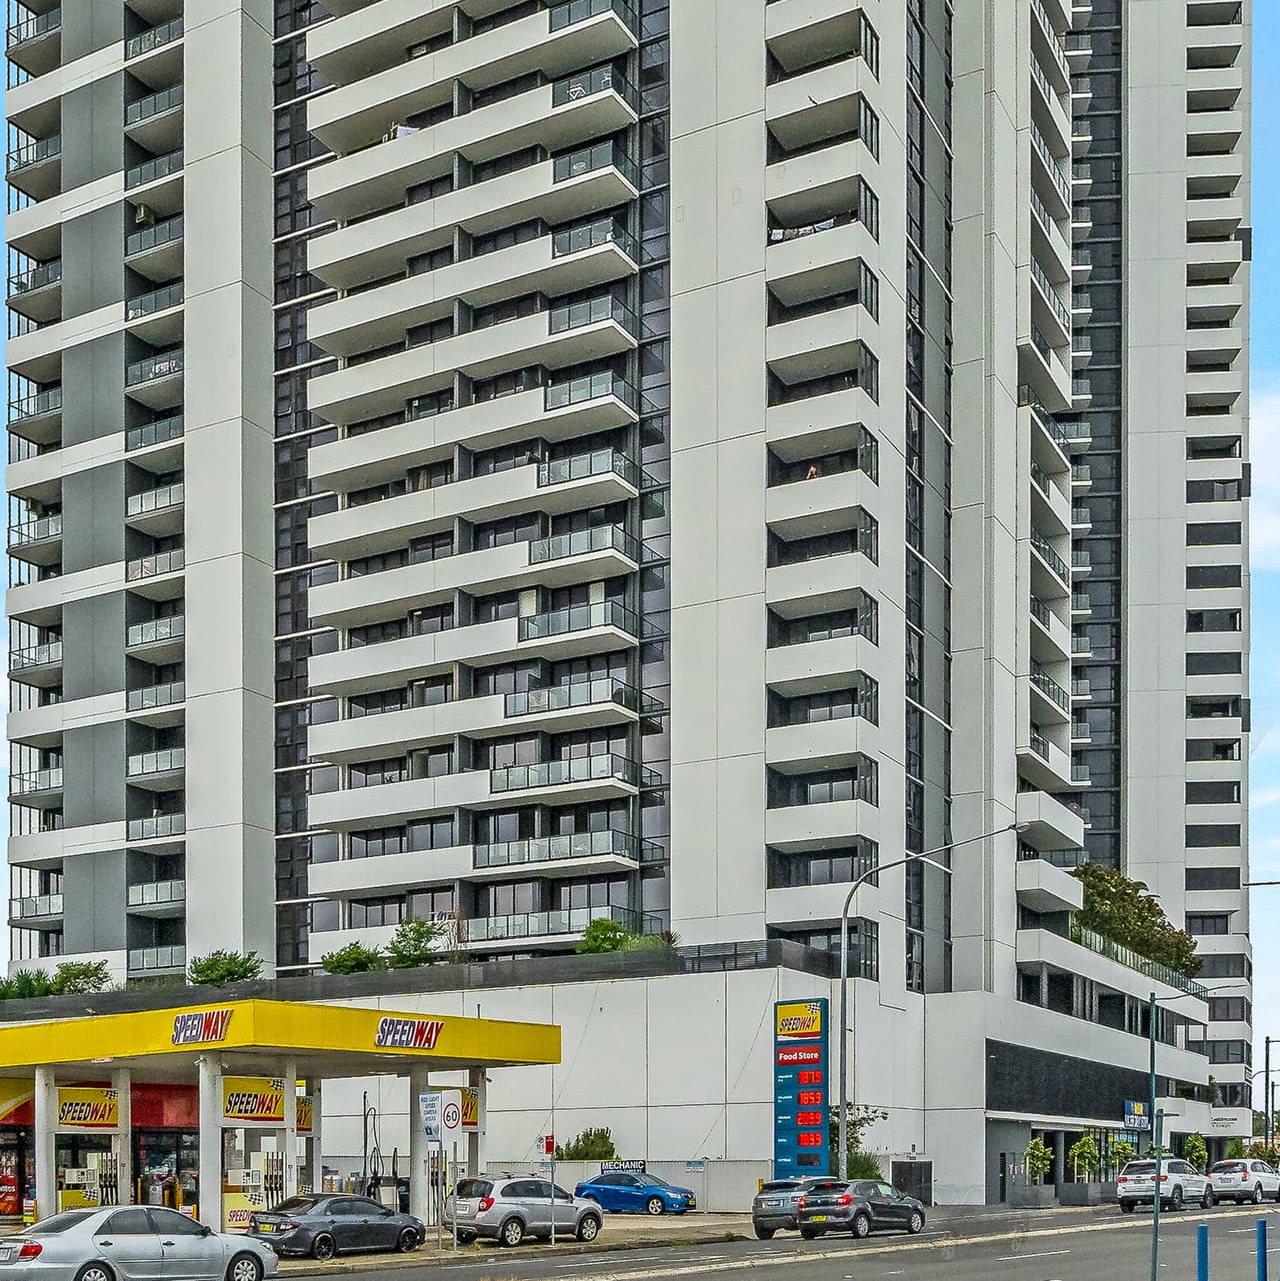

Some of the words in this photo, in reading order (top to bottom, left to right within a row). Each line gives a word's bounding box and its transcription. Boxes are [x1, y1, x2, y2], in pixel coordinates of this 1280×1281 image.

[172, 1009, 233, 1044] SPEEDWAY
[780, 1016, 817, 1031] SPEEDWAY
[375, 1016, 444, 1049] SPEEDWAY
[779, 1052, 798, 1061] Food
[798, 1051, 819, 1060] Store
[59, 1102, 115, 1122] SPEEDWAY
[225, 1093, 282, 1115] SPEEDWAY
[446, 1110, 458, 1122] 60
[601, 1161, 644, 1170] MECHANIC
